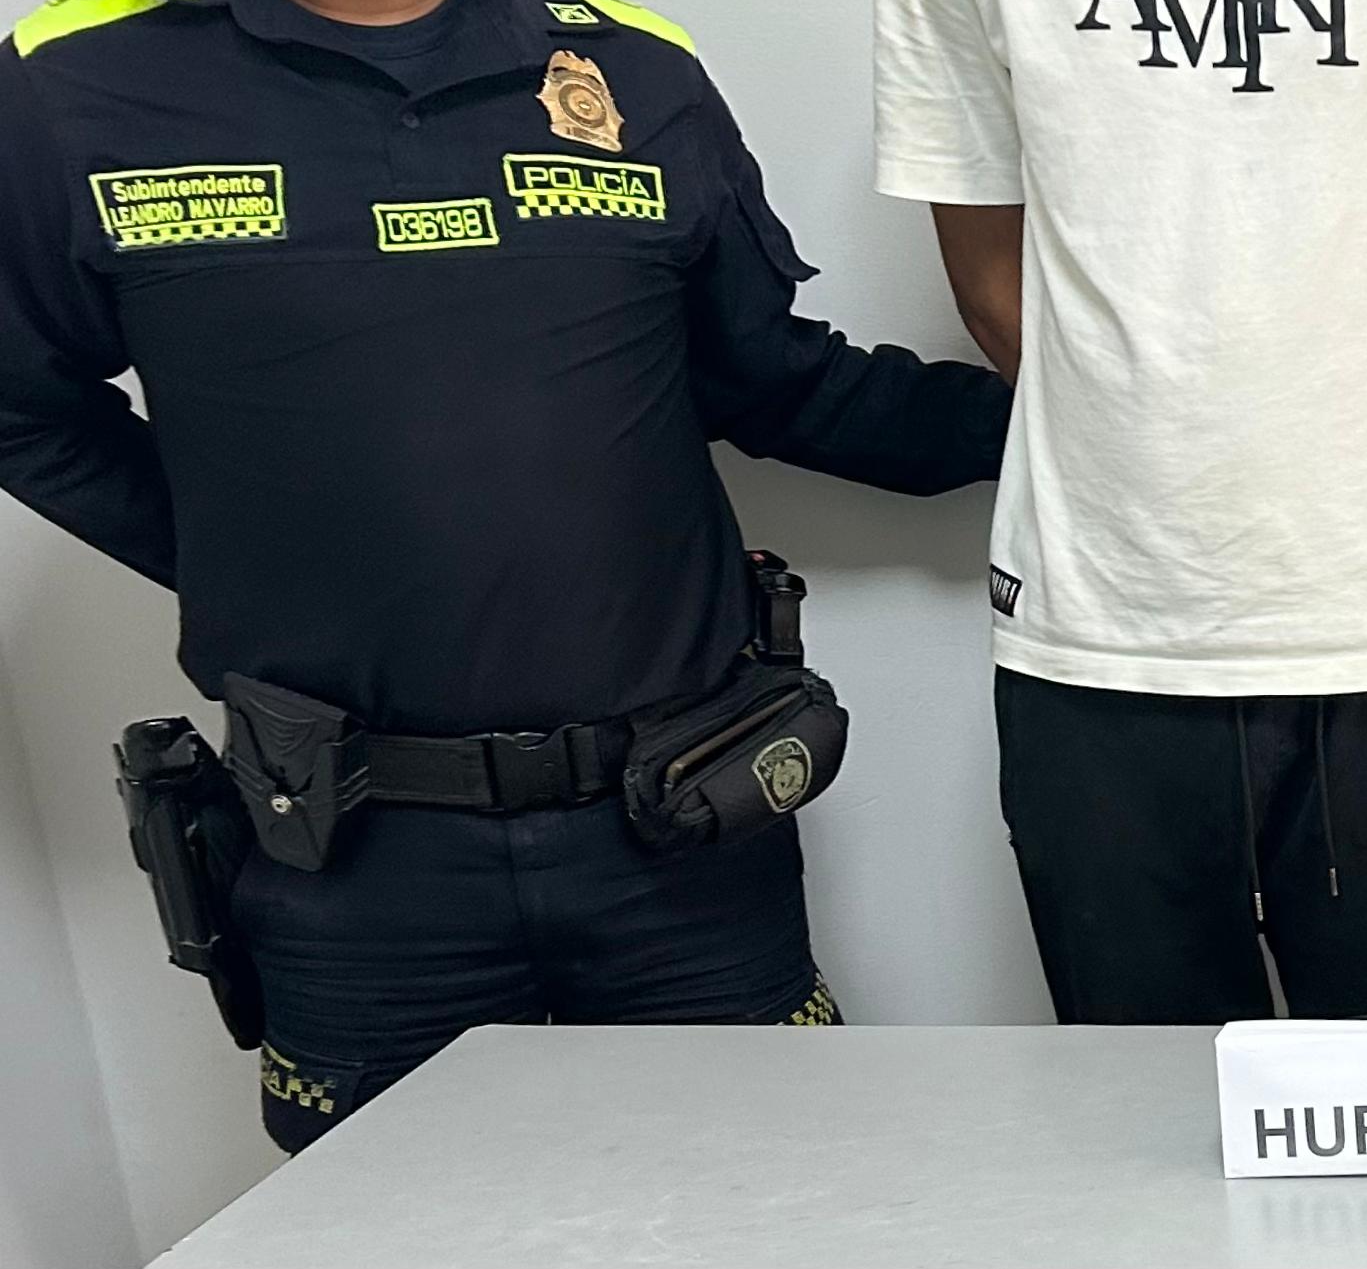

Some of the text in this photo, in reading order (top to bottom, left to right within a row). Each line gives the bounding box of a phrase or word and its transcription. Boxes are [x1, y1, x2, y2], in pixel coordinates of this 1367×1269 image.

[110, 174, 266, 203] Subintendente
[522, 166, 651, 198] POLICÍA
[108, 196, 275, 228] LEANDRO NAVARRO
[385, 207, 483, 243] 036198
